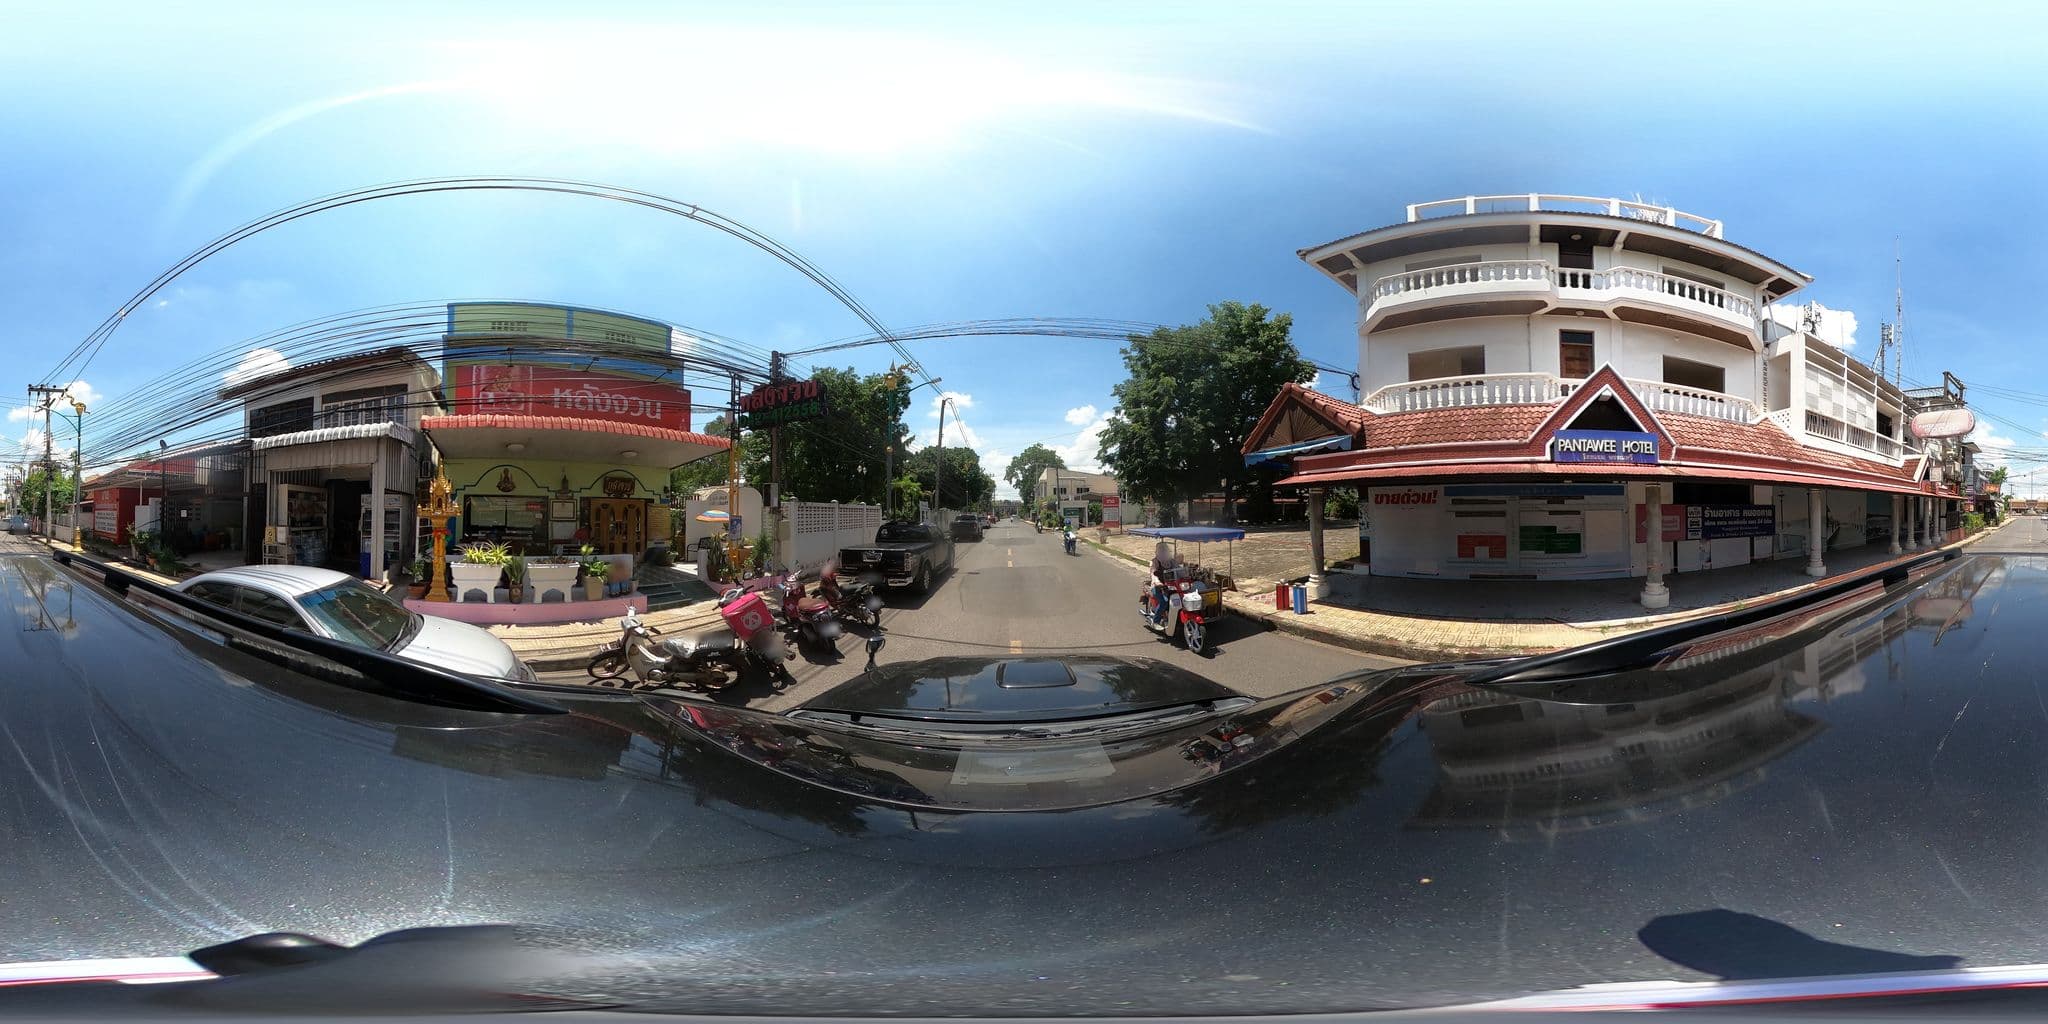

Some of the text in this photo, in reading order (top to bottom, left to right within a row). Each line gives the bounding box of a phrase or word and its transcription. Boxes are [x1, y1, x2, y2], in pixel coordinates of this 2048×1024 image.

[553, 383, 661, 420] หลังจวน
[1558, 438, 1655, 454] PANTAWEE HOTEL
[1374, 489, 1438, 504] ขายด่วน!
